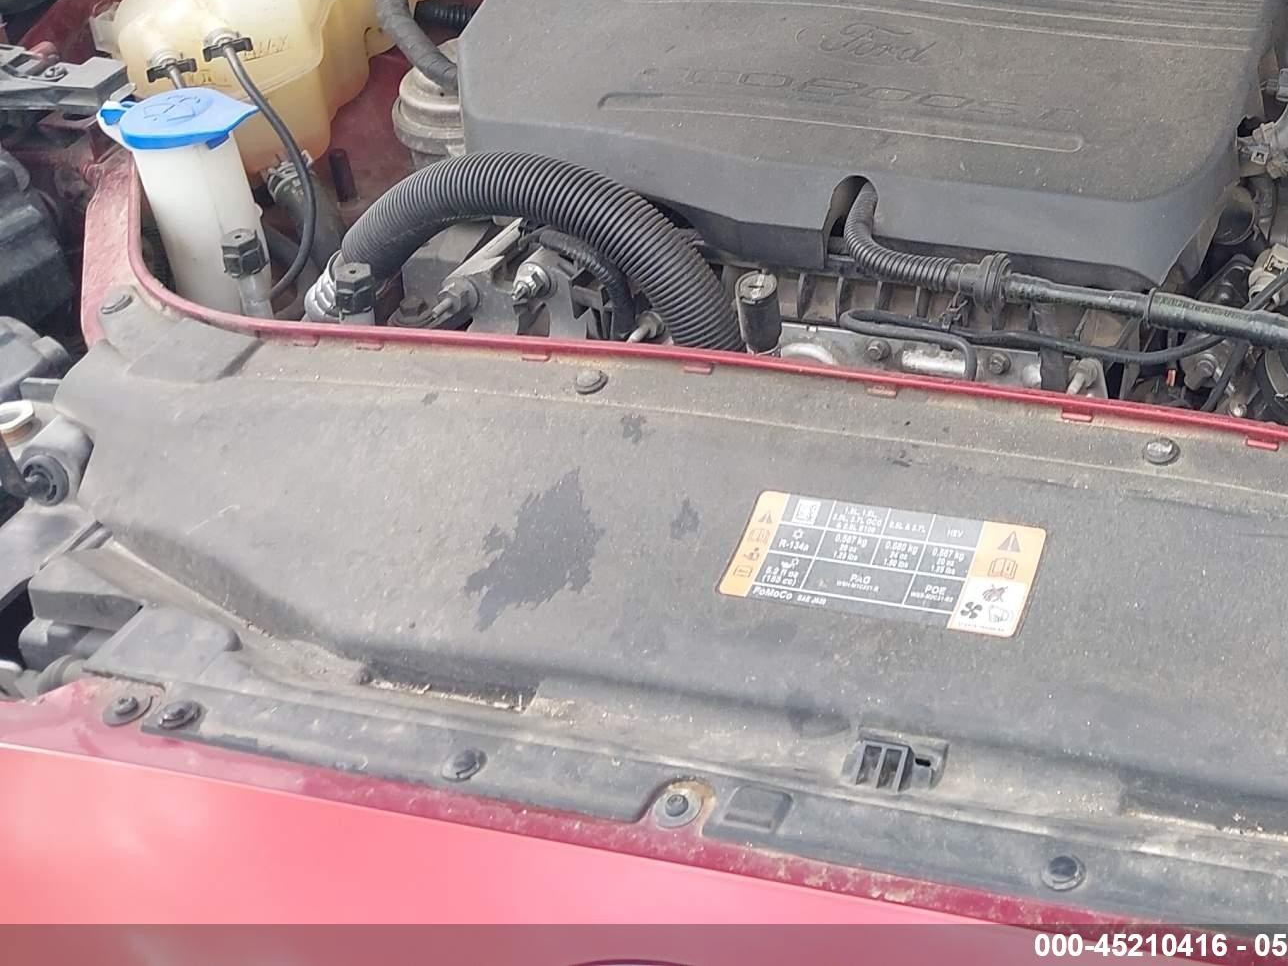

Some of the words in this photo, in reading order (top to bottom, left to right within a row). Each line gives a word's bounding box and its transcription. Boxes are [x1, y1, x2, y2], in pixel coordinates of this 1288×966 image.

[818, 23, 937, 64] Ford
[946, 528, 964, 538] HEV
[777, 538, 810, 551] R-134a
[855, 536, 869, 548] kg
[906, 544, 919, 555] kg
[953, 551, 966, 562] kg
[849, 573, 872, 584] PAG
[752, 586, 794, 600] FoMoCo
[924, 584, 947, 595] POE
